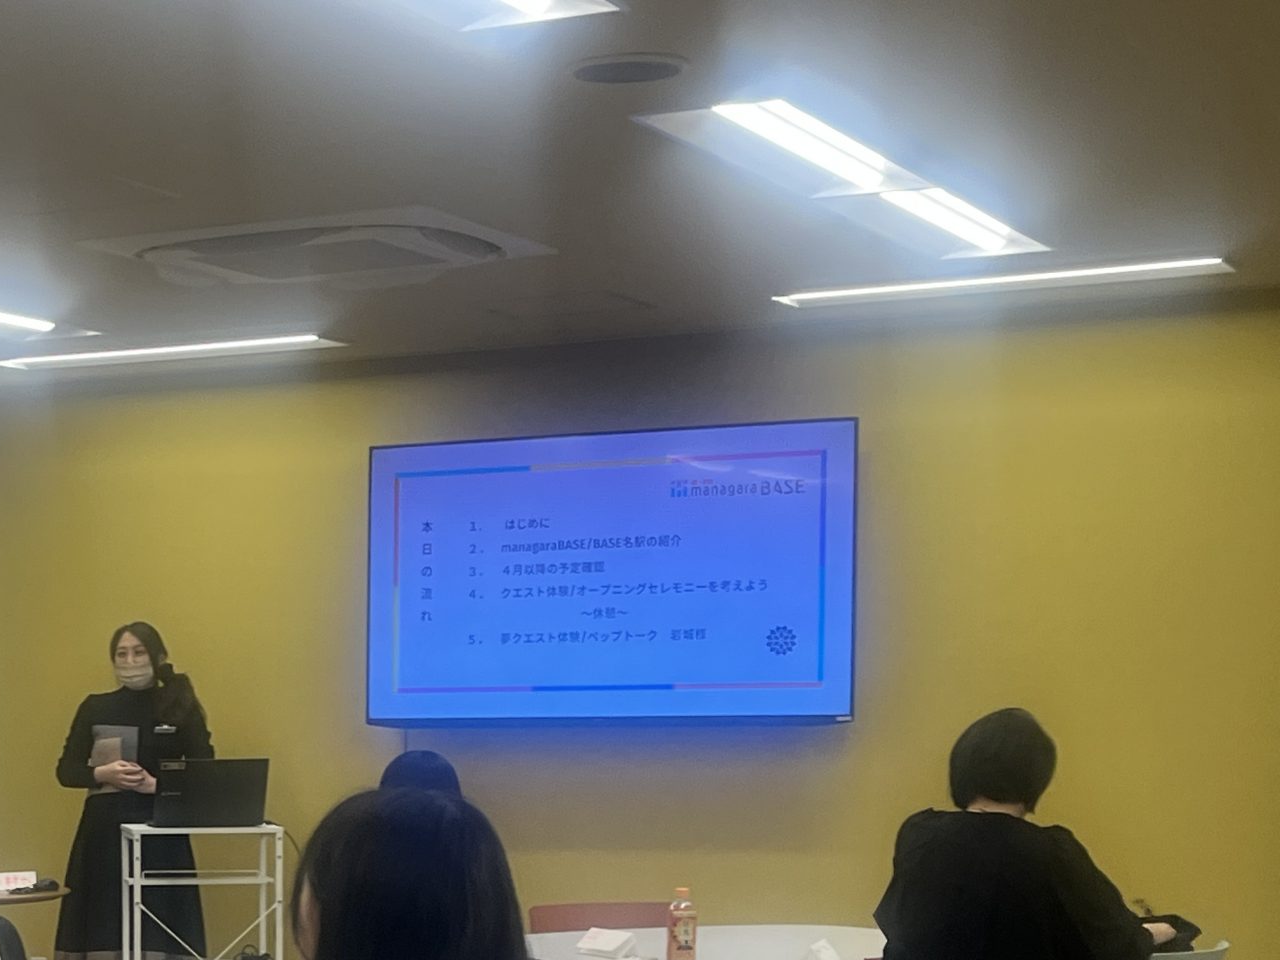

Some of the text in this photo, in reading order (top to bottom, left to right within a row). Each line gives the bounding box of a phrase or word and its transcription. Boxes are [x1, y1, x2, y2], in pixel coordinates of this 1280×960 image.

[690, 482, 758, 497] managara
[760, 479, 806, 496] BASE
[504, 518, 550, 530] はじめに
